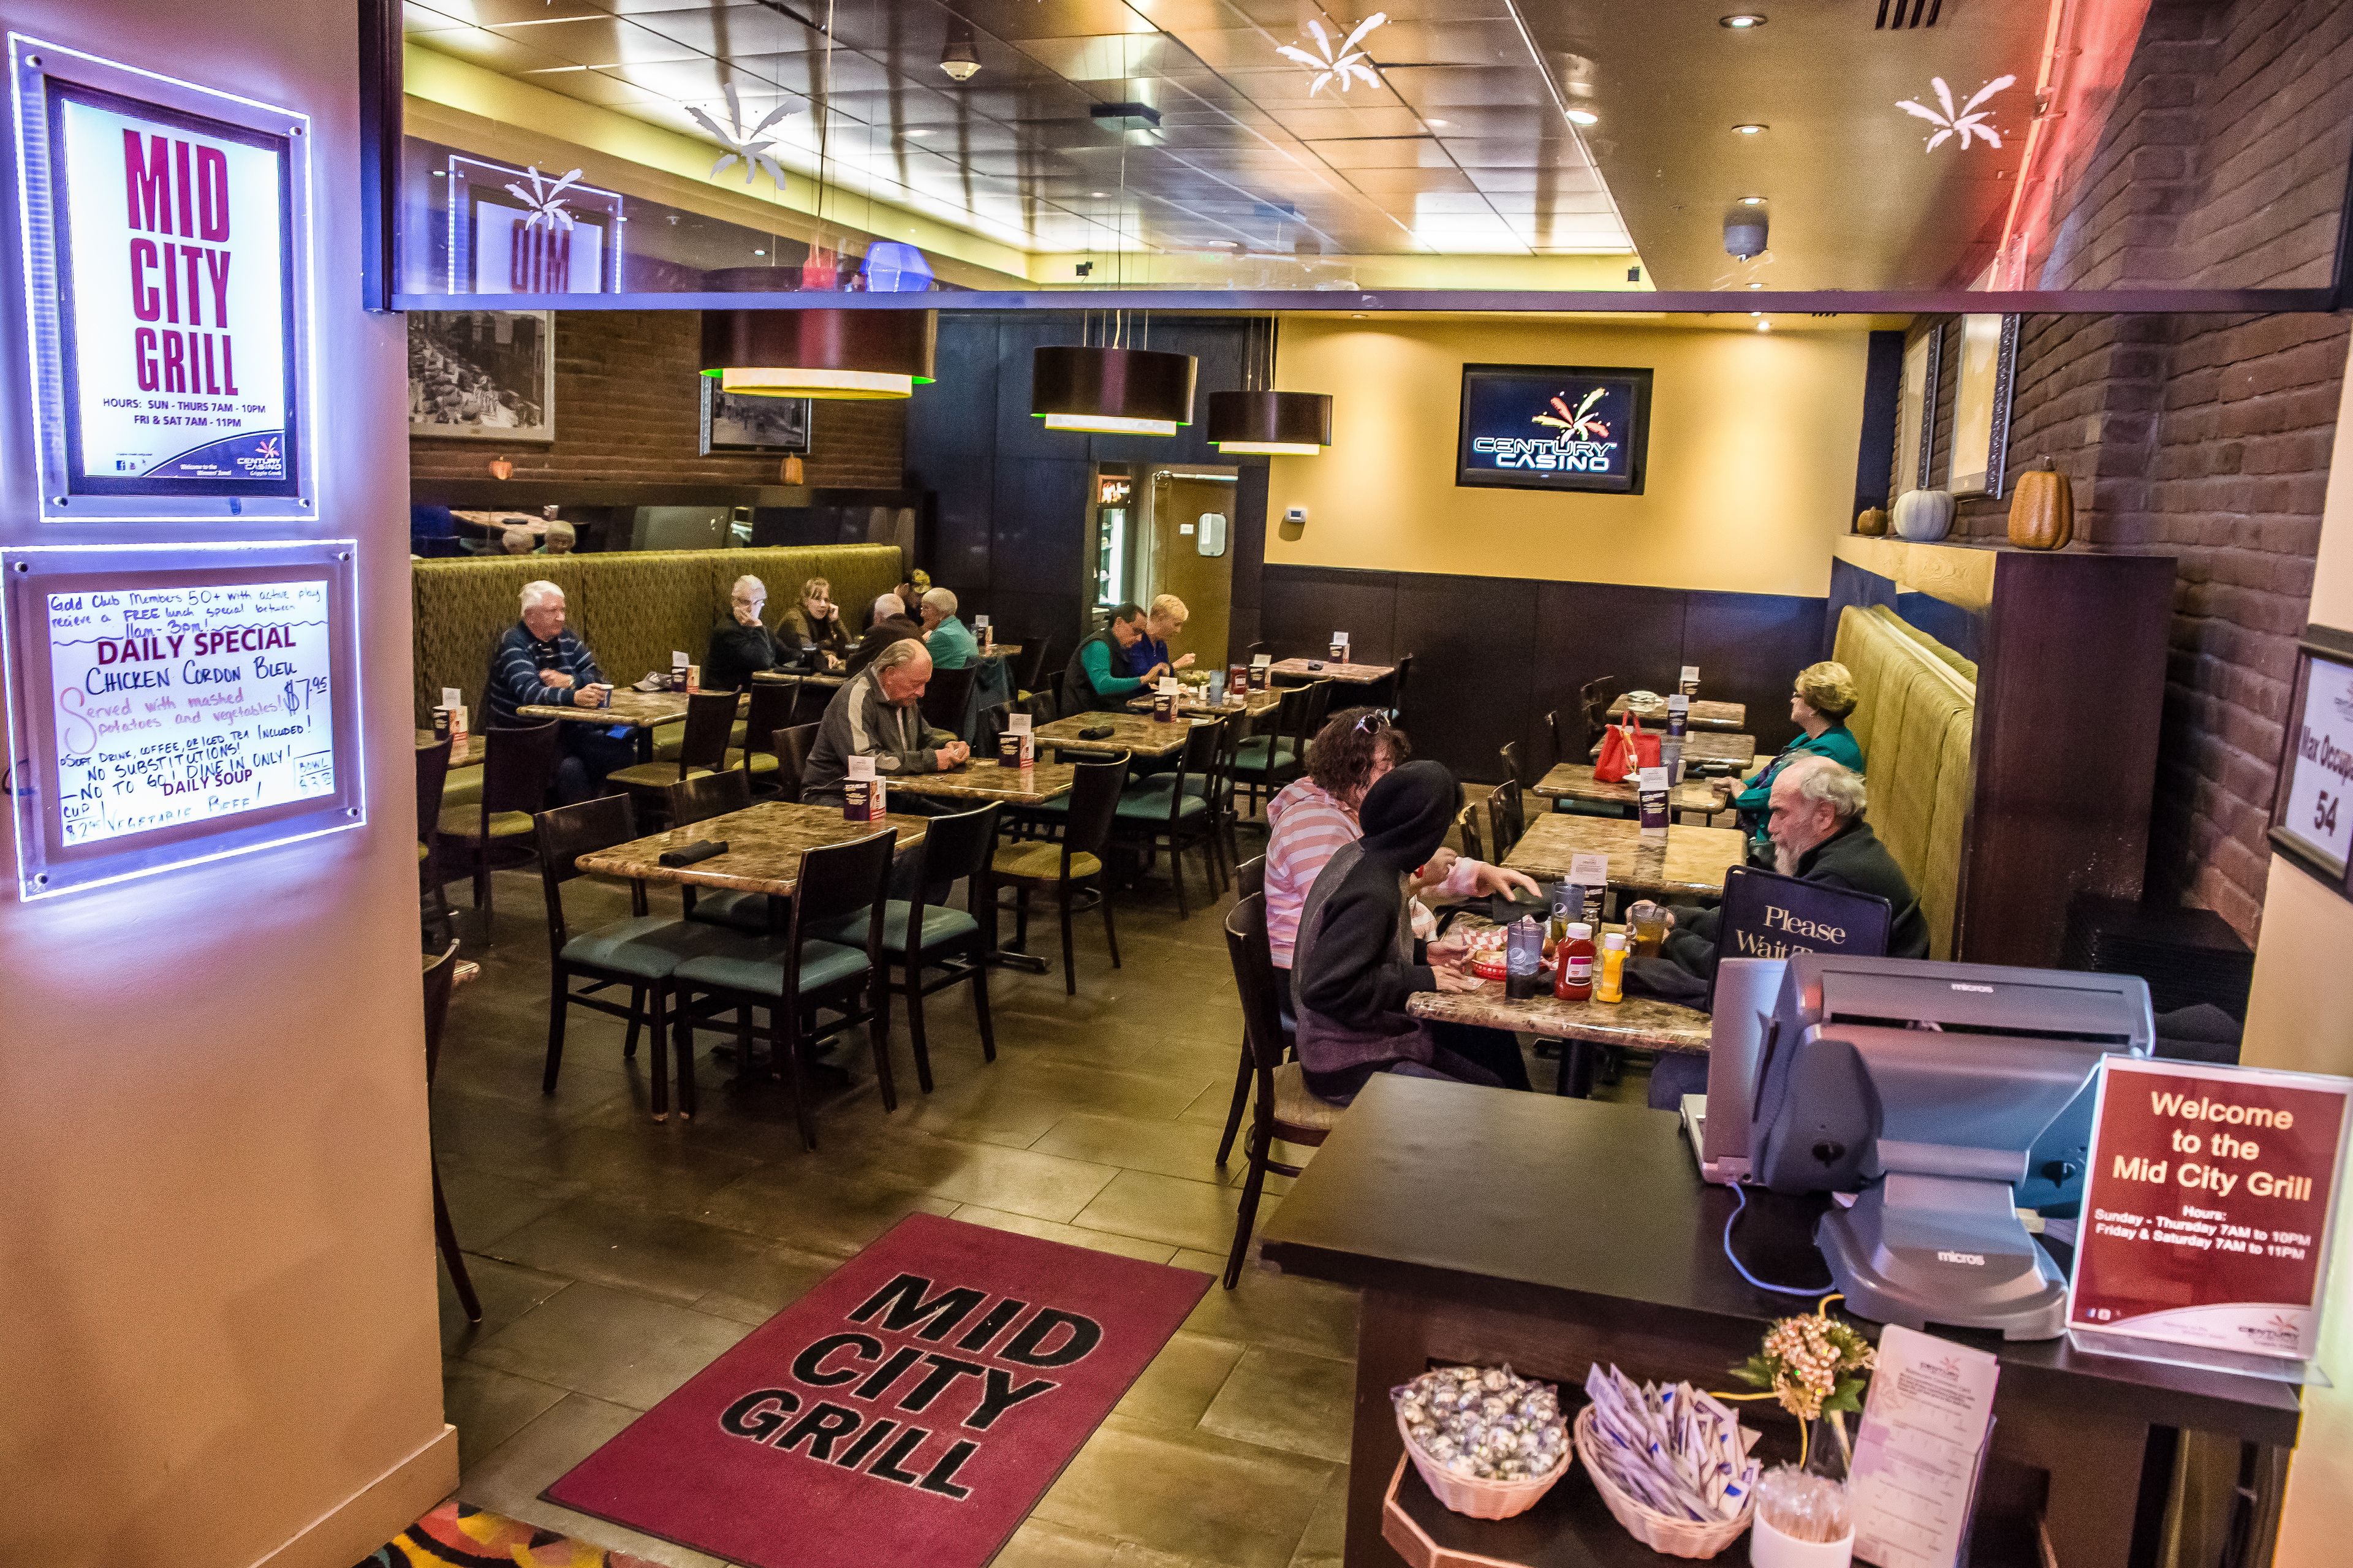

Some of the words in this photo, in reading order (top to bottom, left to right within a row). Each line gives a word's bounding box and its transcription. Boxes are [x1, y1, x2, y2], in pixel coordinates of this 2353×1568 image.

[123, 128, 230, 243] MID
[131, 238, 231, 328] CITY
[135, 327, 238, 396] GRILL
[103, 398, 142, 409] HOURS:
[148, 400, 169, 410] SUN
[177, 401, 209, 412] THURS
[211, 403, 233, 412] 7AM
[241, 404, 266, 413] 10PM
[134, 415, 149, 425] FRI
[153, 416, 161, 425] &
[163, 416, 182, 426] SAT
[185, 417, 207, 426] 7AM
[216, 418, 241, 427] 11PM
[1473, 437, 1612, 458] CENTURY
[1496, 453, 1610, 472] CASINO
[92, 595, 120, 608] Club
[129, 593, 183, 606] Members
[189, 590, 221, 605] 50+
[227, 590, 252, 601] with
[259, 589, 289, 600] active
[299, 589, 320, 602] play
[100, 614, 111, 623] a
[123, 608, 160, 623] FREE
[165, 607, 194, 618] lunch
[207, 604, 244, 617] special
[256, 604, 295, 613] between
[97, 635, 185, 665] DAILY
[194, 626, 297, 657] SPECIAL
[145, 696, 176, 713] with
[188, 686, 244, 708] mashed
[99, 718, 162, 736] potatoes
[175, 711, 202, 725] and
[230, 730, 249, 741] TEA
[80, 782, 103, 800] NO
[113, 780, 134, 795] TO
[186, 760, 224, 779] DINE
[230, 756, 245, 771] IN
[88, 766, 106, 781] NO
[164, 775, 210, 796] DAILY
[215, 768, 252, 787] SOUP
[63, 803, 90, 818] CUP
[2314, 790, 2340, 838] 54
[1763, 905, 1847, 944] Please
[1735, 928, 1790, 960] Wait
[2151, 1091, 2294, 1131] Welcome
[2172, 1128, 2202, 1154] to
[2210, 1133, 2260, 1161] the
[2112, 1154, 2169, 1185] Mid
[2177, 1162, 2239, 1198] City
[2246, 1171, 2313, 1202] Grill
[2094, 1208, 2144, 1228] Sunday
[2155, 1215, 2218, 1237] Thursday
[2219, 1224, 2251, 1240] 7AM
[2253, 1229, 2268, 1241] to
[2271, 1230, 2312, 1247] 10PM
[2181, 1205, 2227, 1222] Hours:
[2095, 1222, 2137, 1241] Friday
[2139, 1228, 2150, 1241] &
[2153, 1230, 2213, 1251] Saturday
[2215, 1237, 2246, 1252] 7AM
[2248, 1243, 2264, 1256] to
[2267, 1246, 2306, 1261] 11PM
[1937, 1251, 1985, 1266] micros
[844, 1271, 1104, 1369] MID
[790, 1331, 1062, 1432] CITY
[719, 1387, 982, 1502] GRILL
